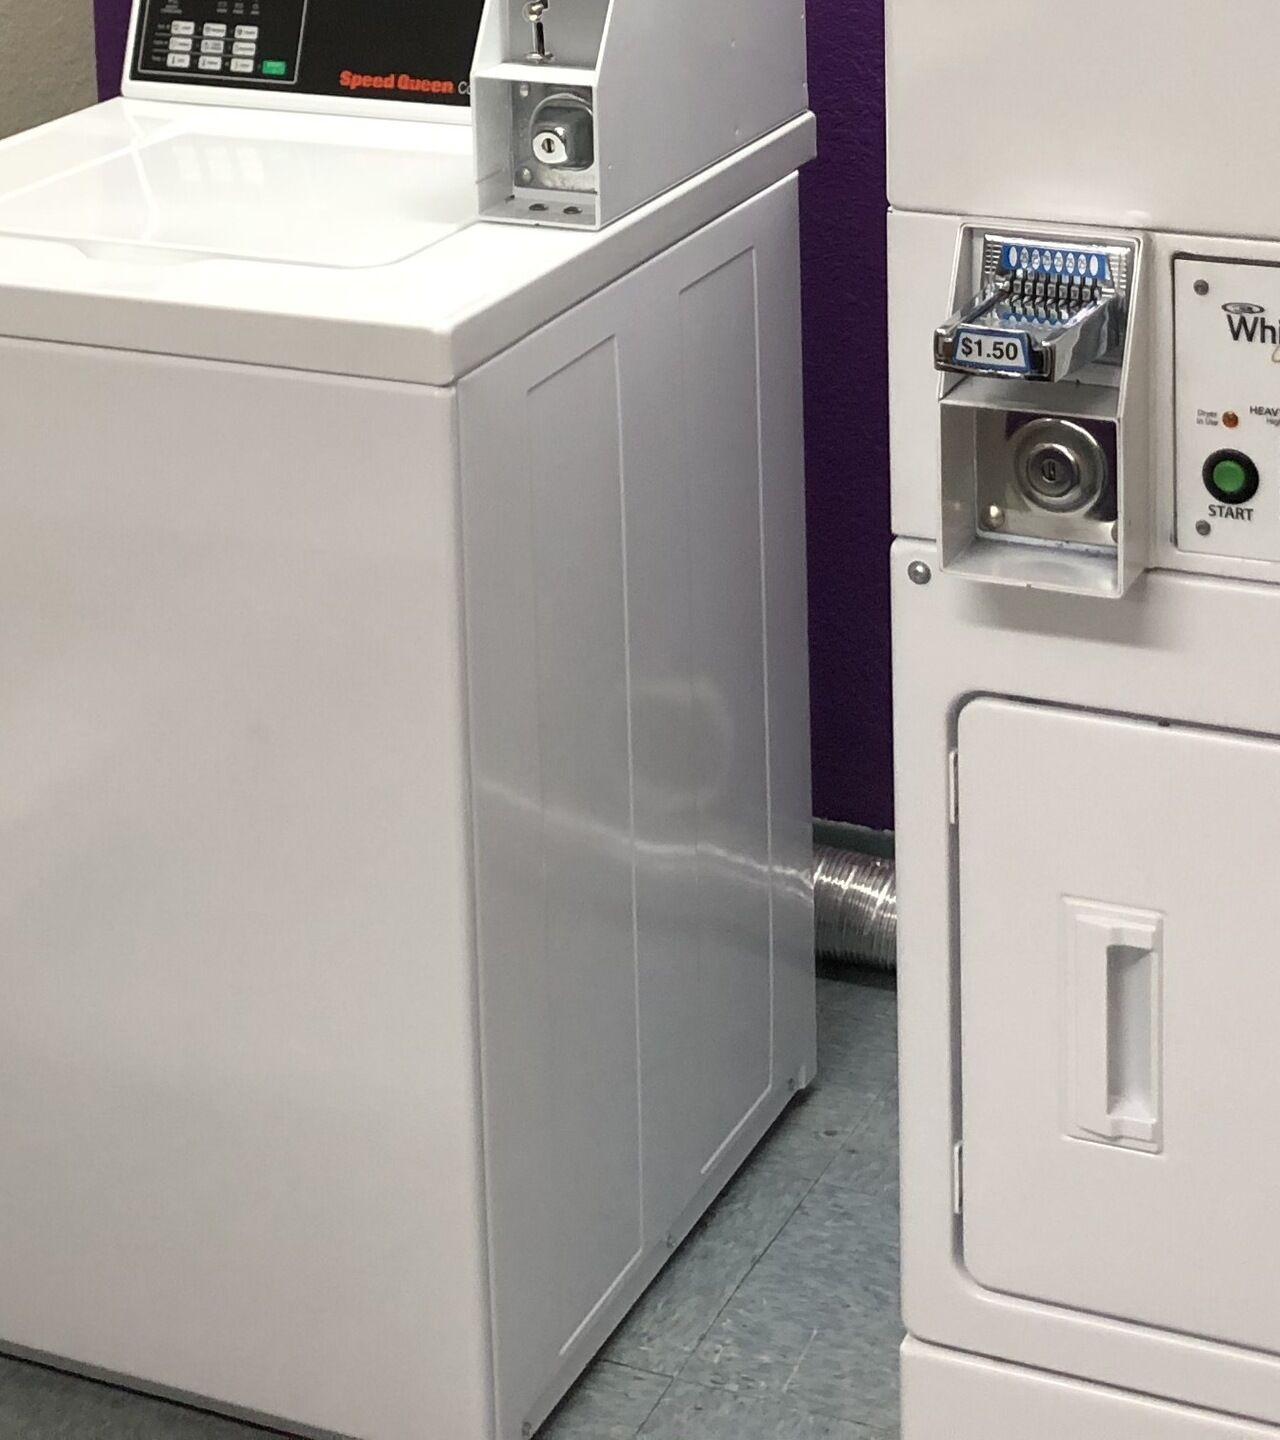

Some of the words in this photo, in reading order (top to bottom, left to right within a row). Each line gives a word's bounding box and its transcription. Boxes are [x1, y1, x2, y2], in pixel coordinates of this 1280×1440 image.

[340, 70, 395, 89] Speed
[397, 74, 454, 94] Queen
[960, 336, 1019, 361] $1.50
[1208, 504, 1254, 521] START
